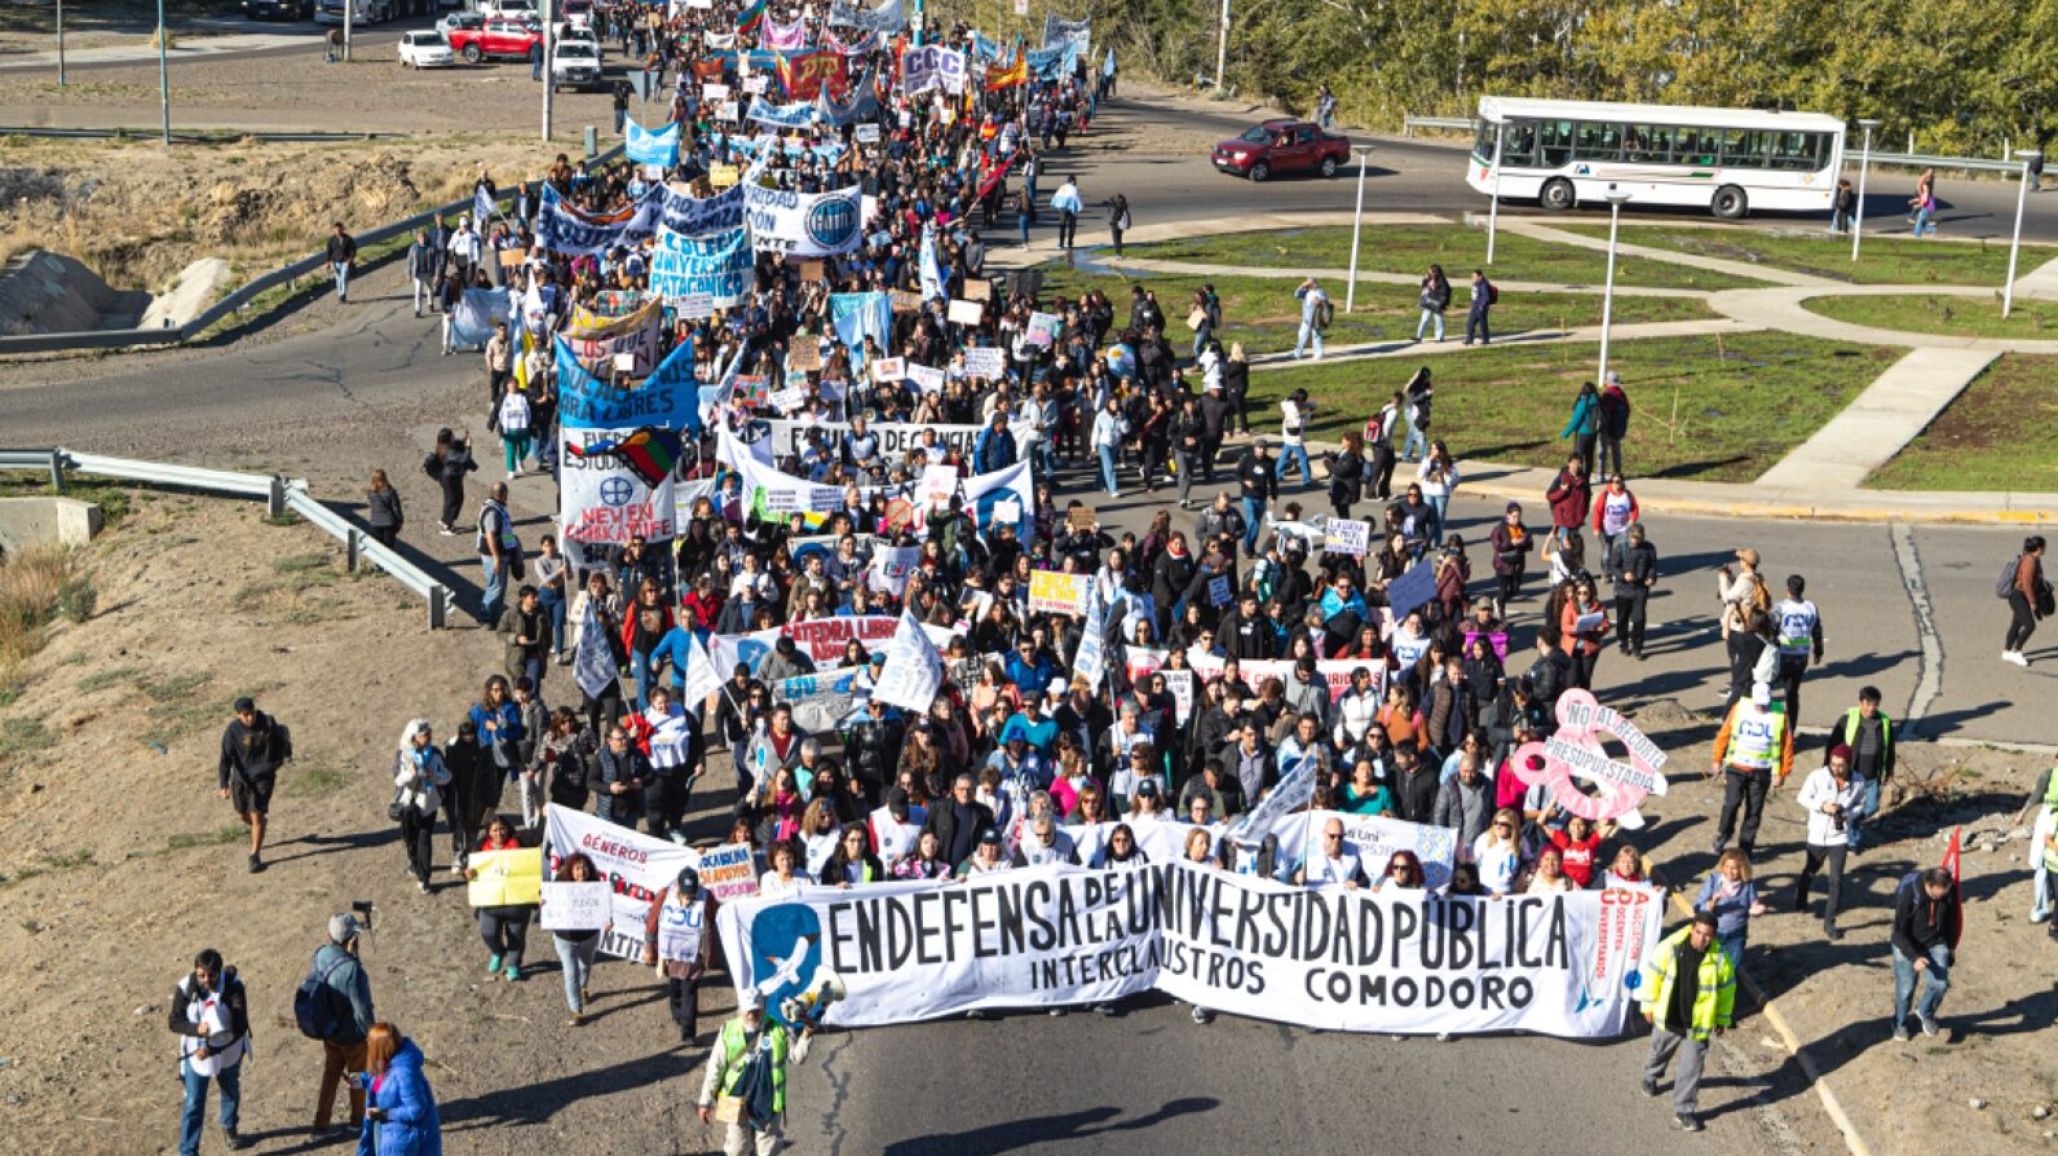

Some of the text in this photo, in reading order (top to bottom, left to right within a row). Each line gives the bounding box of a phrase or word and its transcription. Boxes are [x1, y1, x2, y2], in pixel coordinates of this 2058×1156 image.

[908, 48, 960, 75] CCC
[885, 429, 908, 453] DE
[857, 618, 898, 640] LIBR
[1568, 704, 1665, 770] NO AL RECORTE
[582, 832, 648, 865] GÉNEROS
[1085, 877, 1119, 906] DE
[1087, 911, 1125, 950] LA
[1305, 967, 1533, 1009] COMODORO
